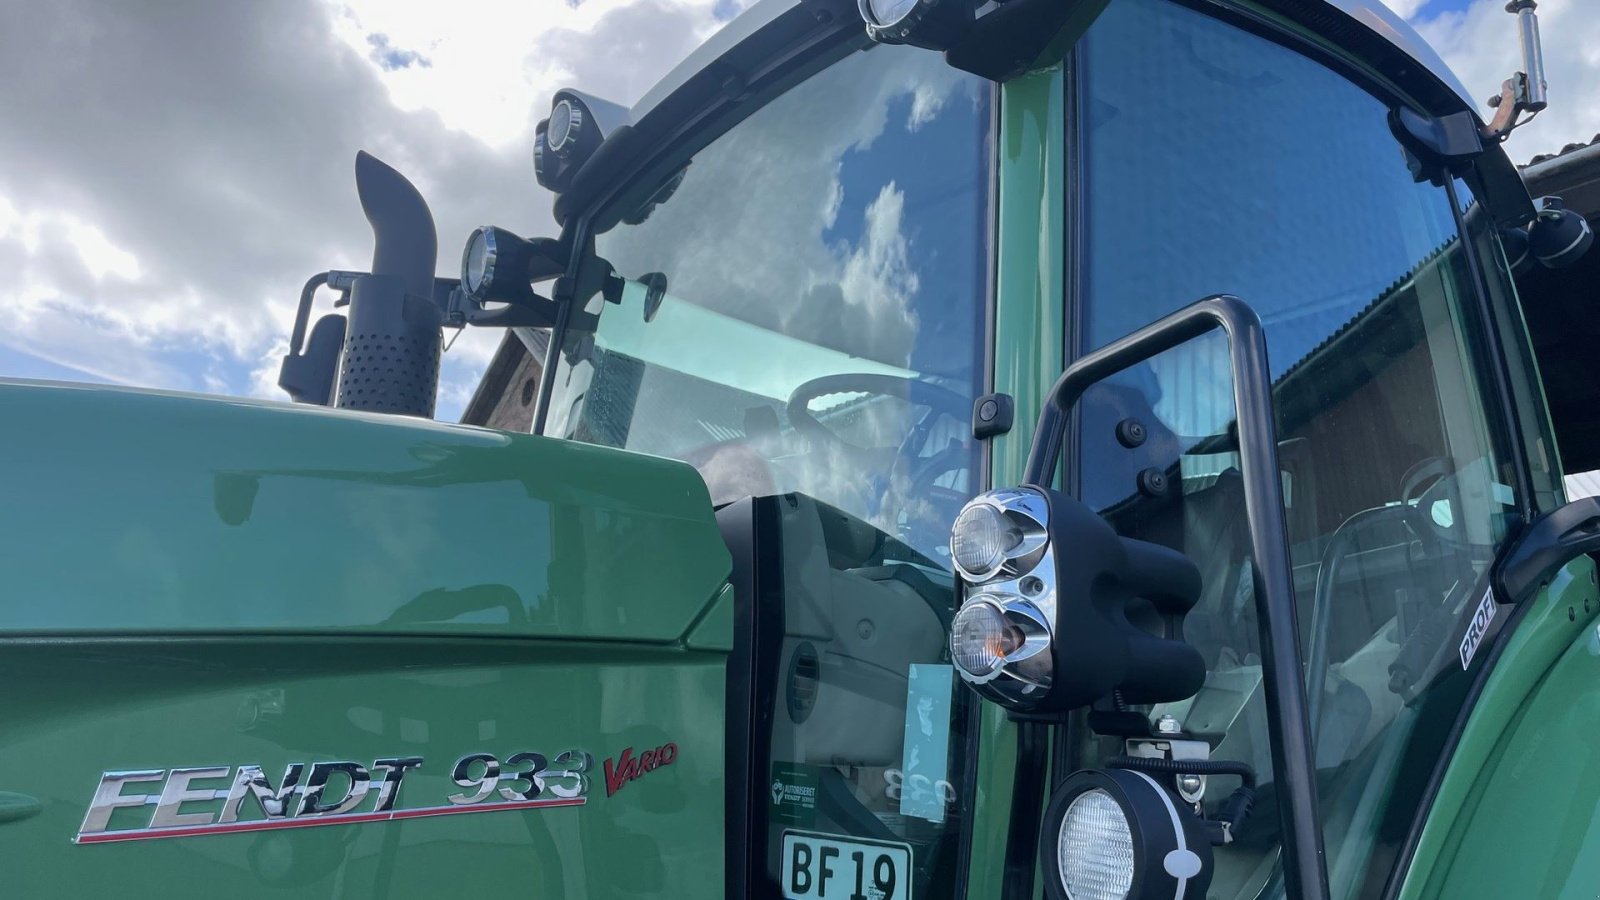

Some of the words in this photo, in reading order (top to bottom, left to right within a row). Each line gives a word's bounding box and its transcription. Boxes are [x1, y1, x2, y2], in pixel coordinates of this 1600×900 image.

[1461, 590, 1495, 662] PROFI
[79, 757, 424, 833] FENDT
[448, 751, 594, 805] 933
[791, 842, 839, 897] BF
[850, 851, 896, 900] 19
